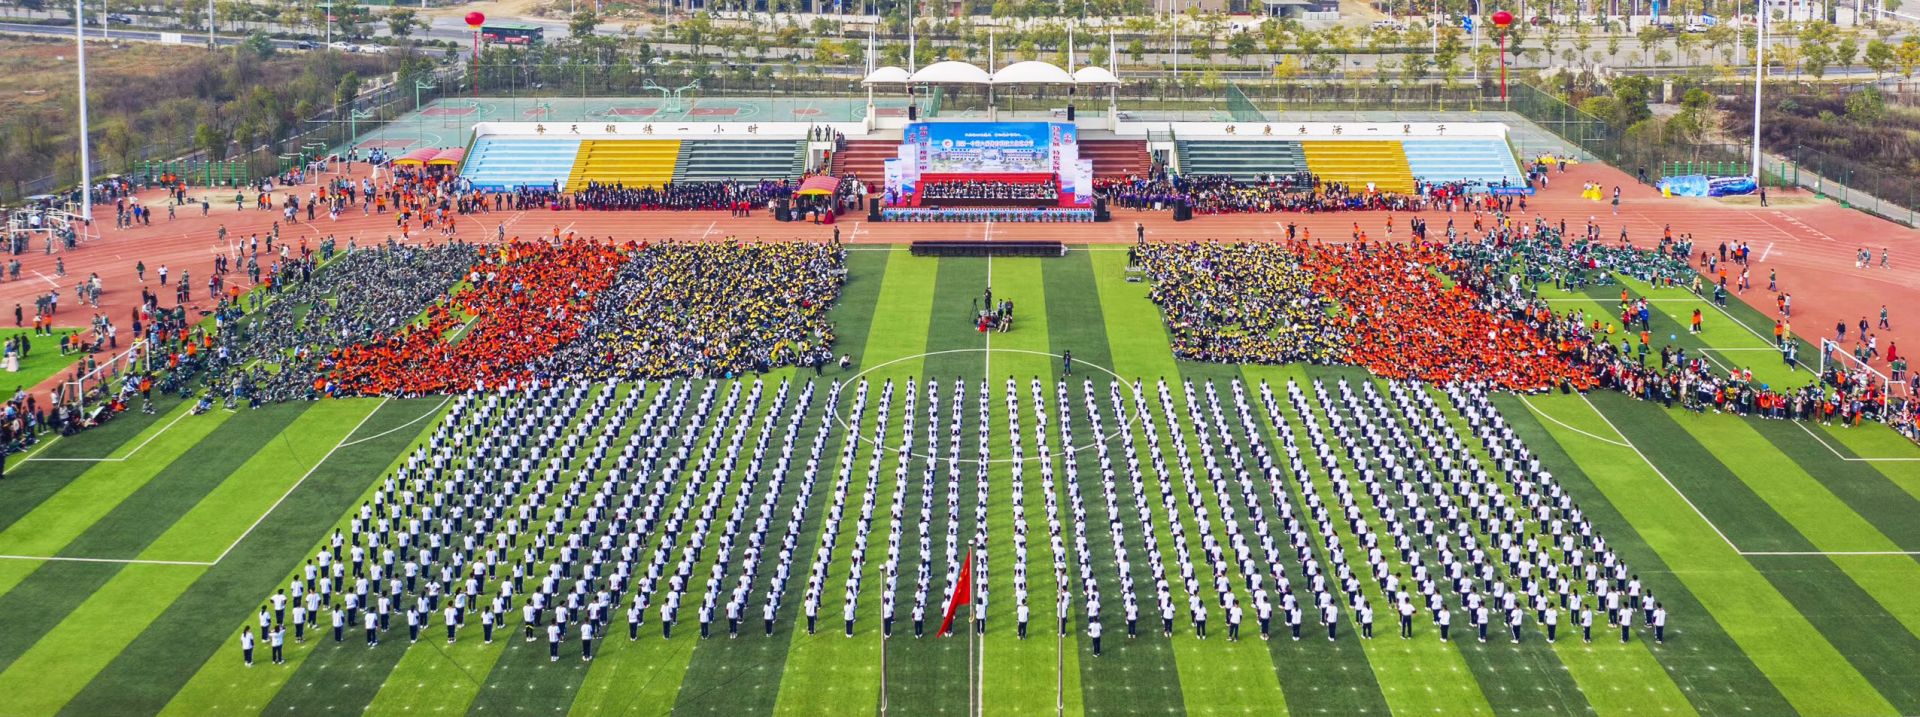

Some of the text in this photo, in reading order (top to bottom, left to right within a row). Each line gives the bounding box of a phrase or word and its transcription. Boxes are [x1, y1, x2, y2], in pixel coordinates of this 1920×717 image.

[536, 123, 758, 134] 每天锻炼一小时
[1225, 124, 1446, 135] 健康生活一辈子
